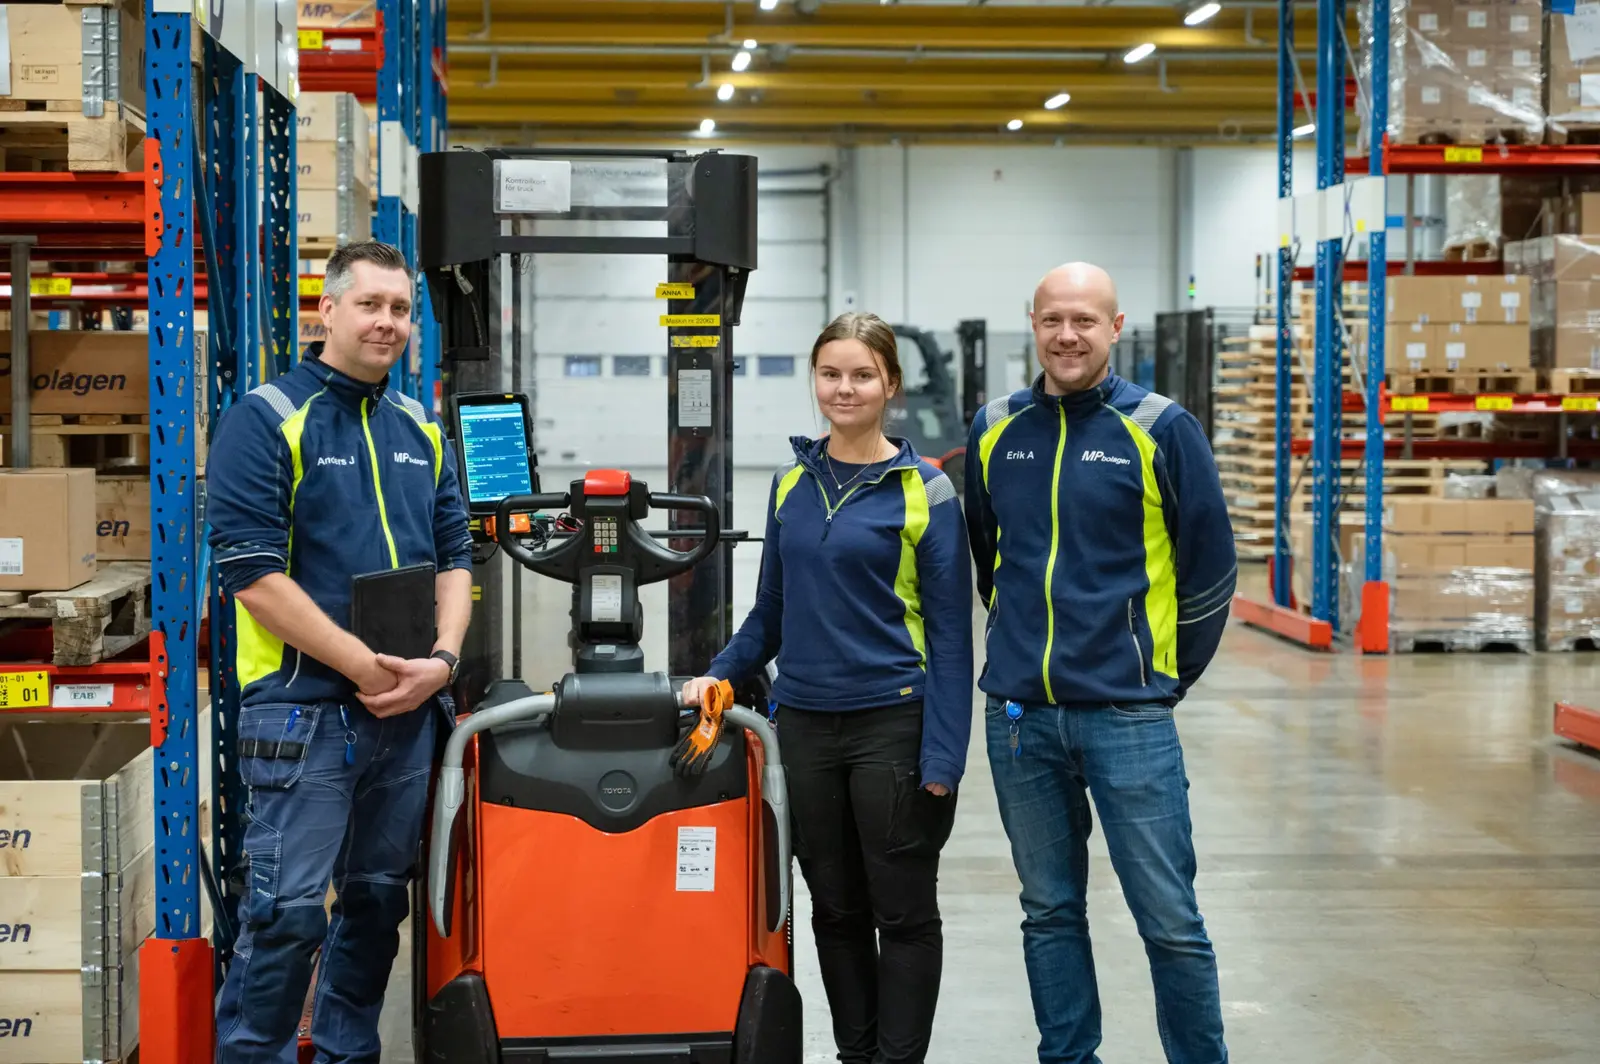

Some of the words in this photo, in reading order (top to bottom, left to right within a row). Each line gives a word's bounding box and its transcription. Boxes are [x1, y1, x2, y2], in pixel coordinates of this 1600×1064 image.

[31, 369, 127, 396] olagen
[348, 455, 355, 465] J
[1006, 451, 1025, 460] Erik
[1026, 451, 1035, 459] A
[23, 688, 38, 702] 01
[73, 692, 94, 700] EAB
